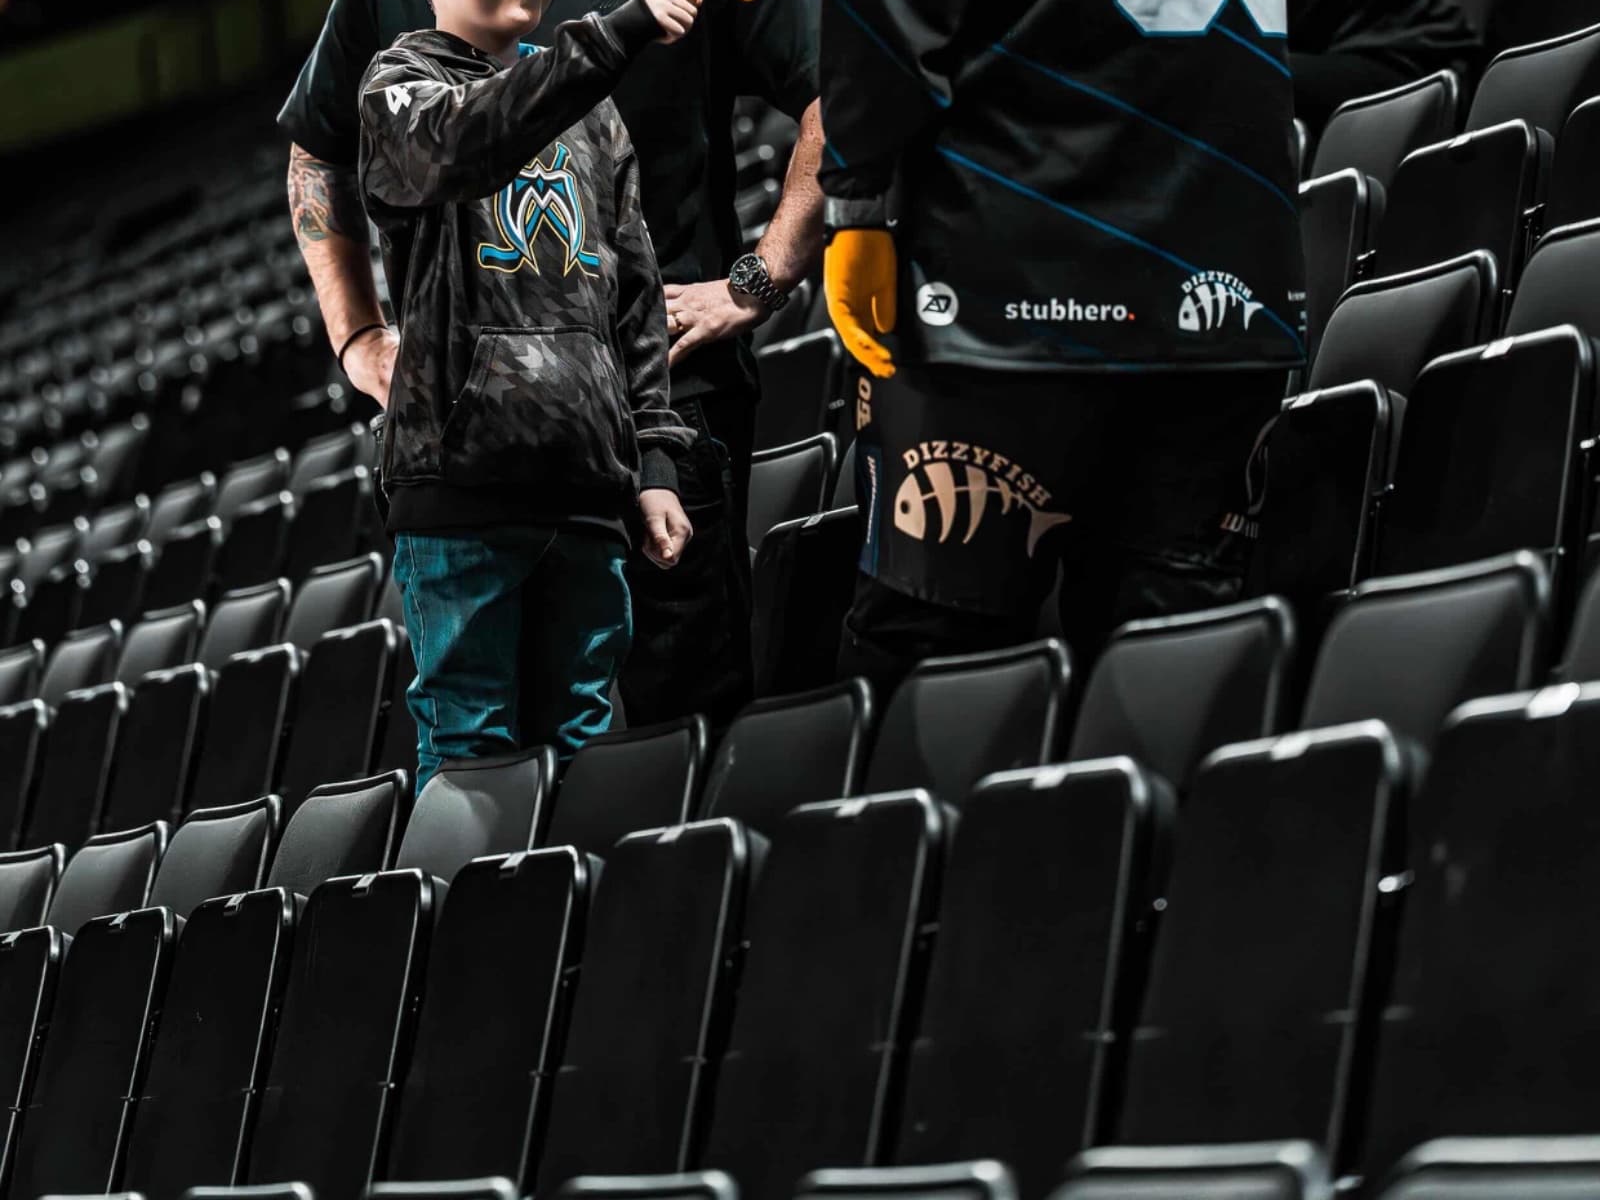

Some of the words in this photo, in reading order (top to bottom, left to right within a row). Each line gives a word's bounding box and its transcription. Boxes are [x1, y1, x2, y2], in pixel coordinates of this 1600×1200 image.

[1181, 270, 1253, 300] DIZZYFISH
[1004, 297, 1135, 322] stubhero.
[903, 440, 1052, 507] DIZZYFISH
